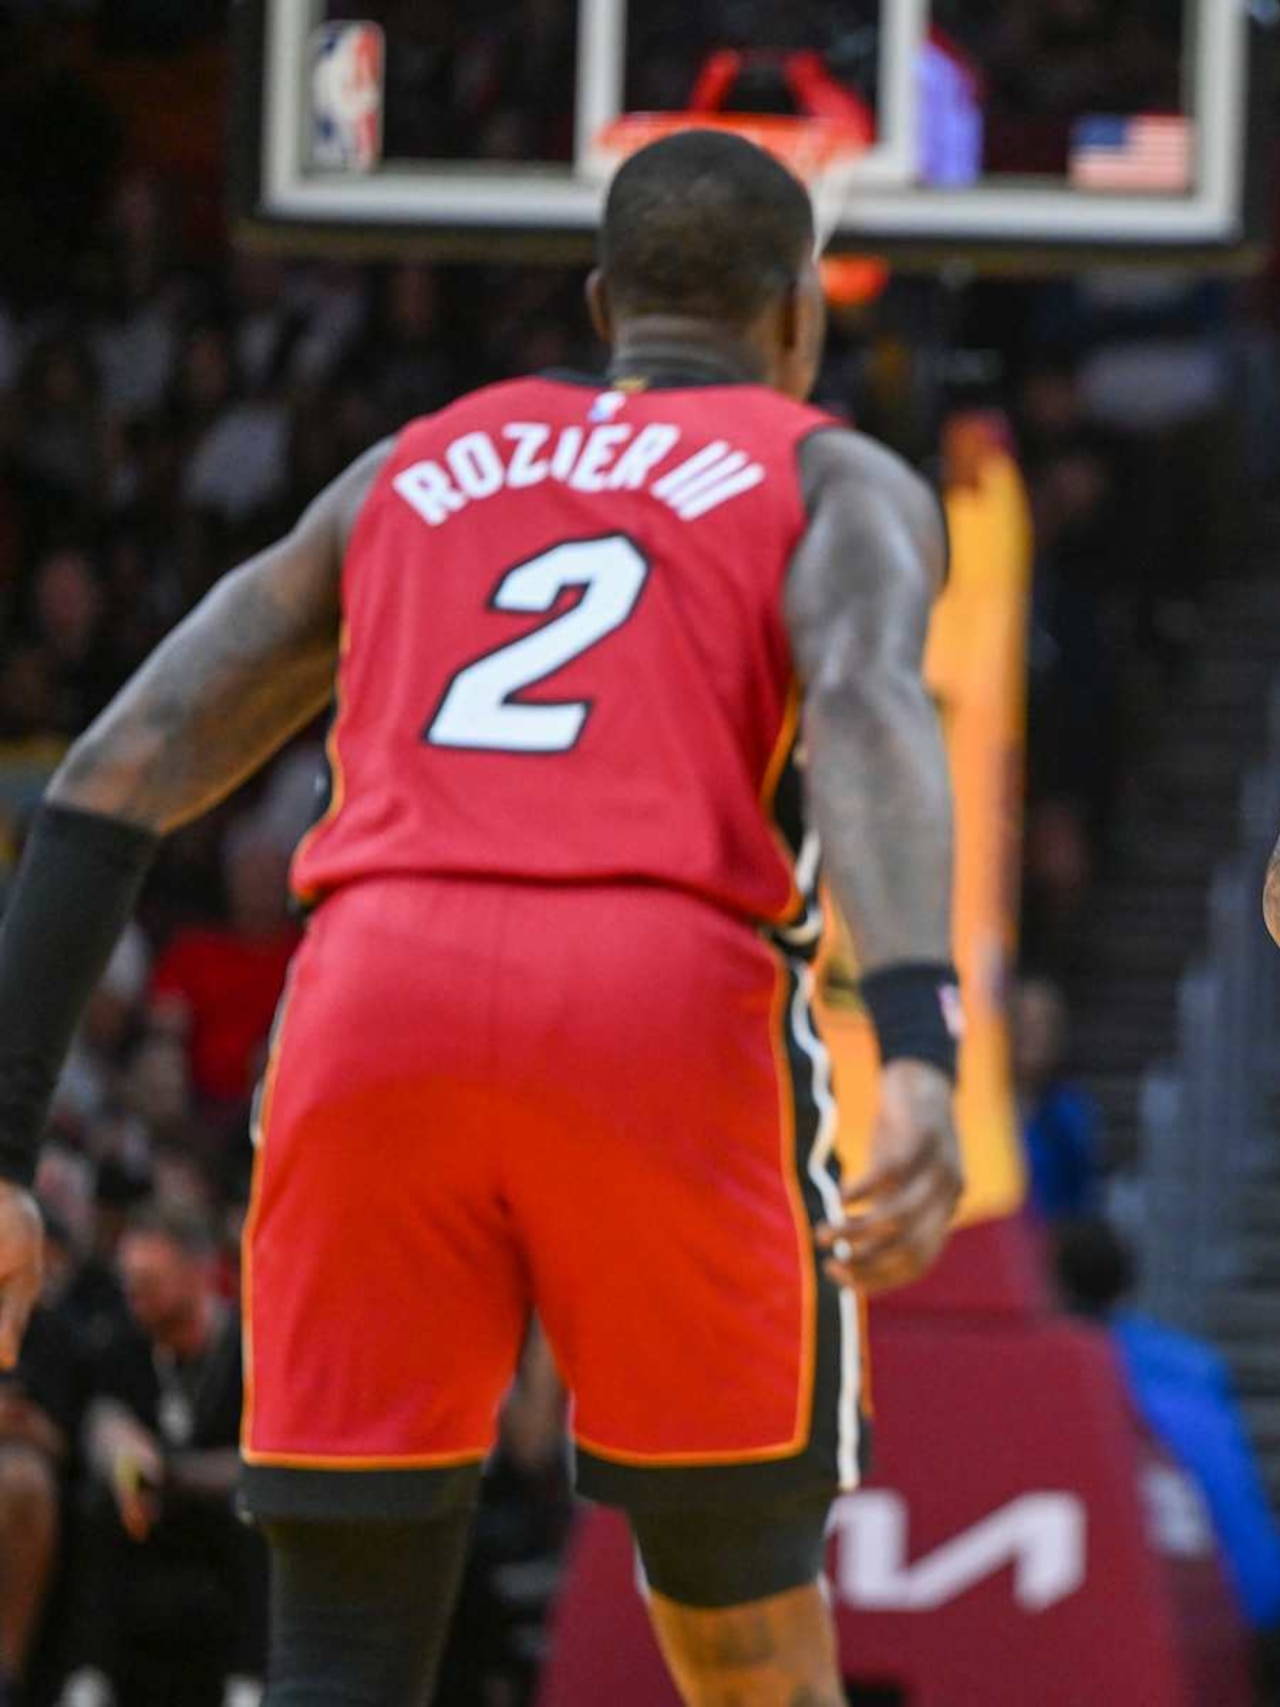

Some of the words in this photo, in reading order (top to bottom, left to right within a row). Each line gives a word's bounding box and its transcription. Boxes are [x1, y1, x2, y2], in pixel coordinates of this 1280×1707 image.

[393, 422, 680, 526] ROZIER
[650, 440, 765, 522] III
[423, 532, 655, 755] 2
